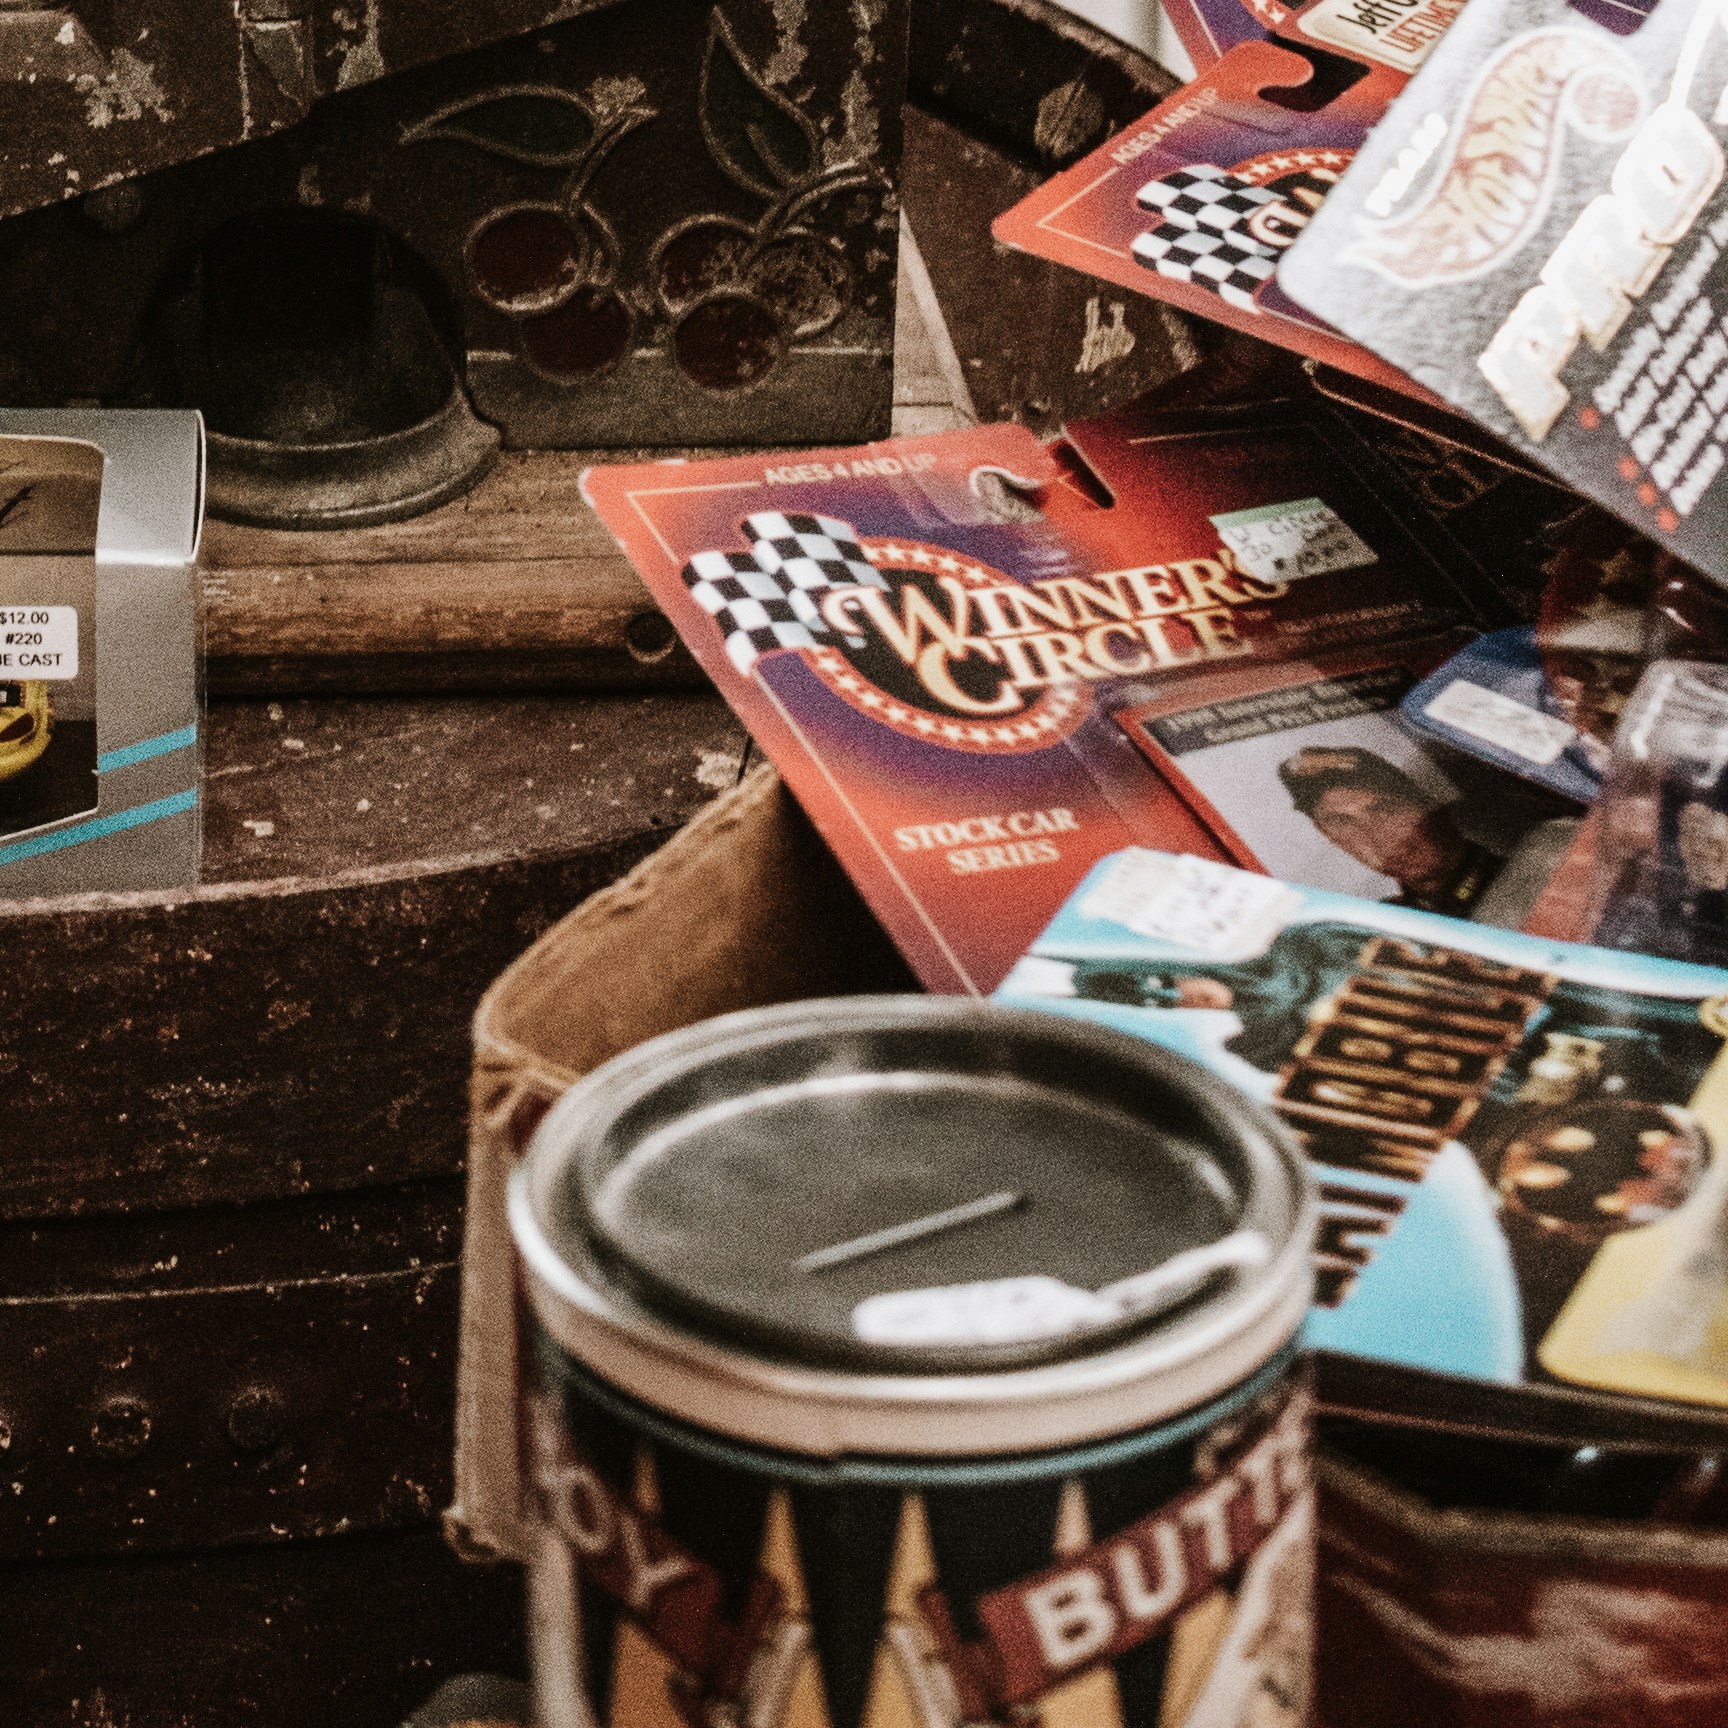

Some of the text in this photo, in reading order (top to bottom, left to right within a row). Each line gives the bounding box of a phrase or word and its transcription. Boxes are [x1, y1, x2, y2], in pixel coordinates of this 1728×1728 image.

[764, 463, 834, 486] AGES
[850, 456, 904, 477] AND
[822, 547, 1289, 662] WINNER'S
[4, 631, 43, 646] #220
[18, 652, 64, 667] CAST
[916, 608, 1254, 713] CIRCLE
[893, 807, 1081, 853] STOCK CAR
[946, 838, 1061, 876] SERIES
[1276, 936, 1560, 1311] MOBILE
